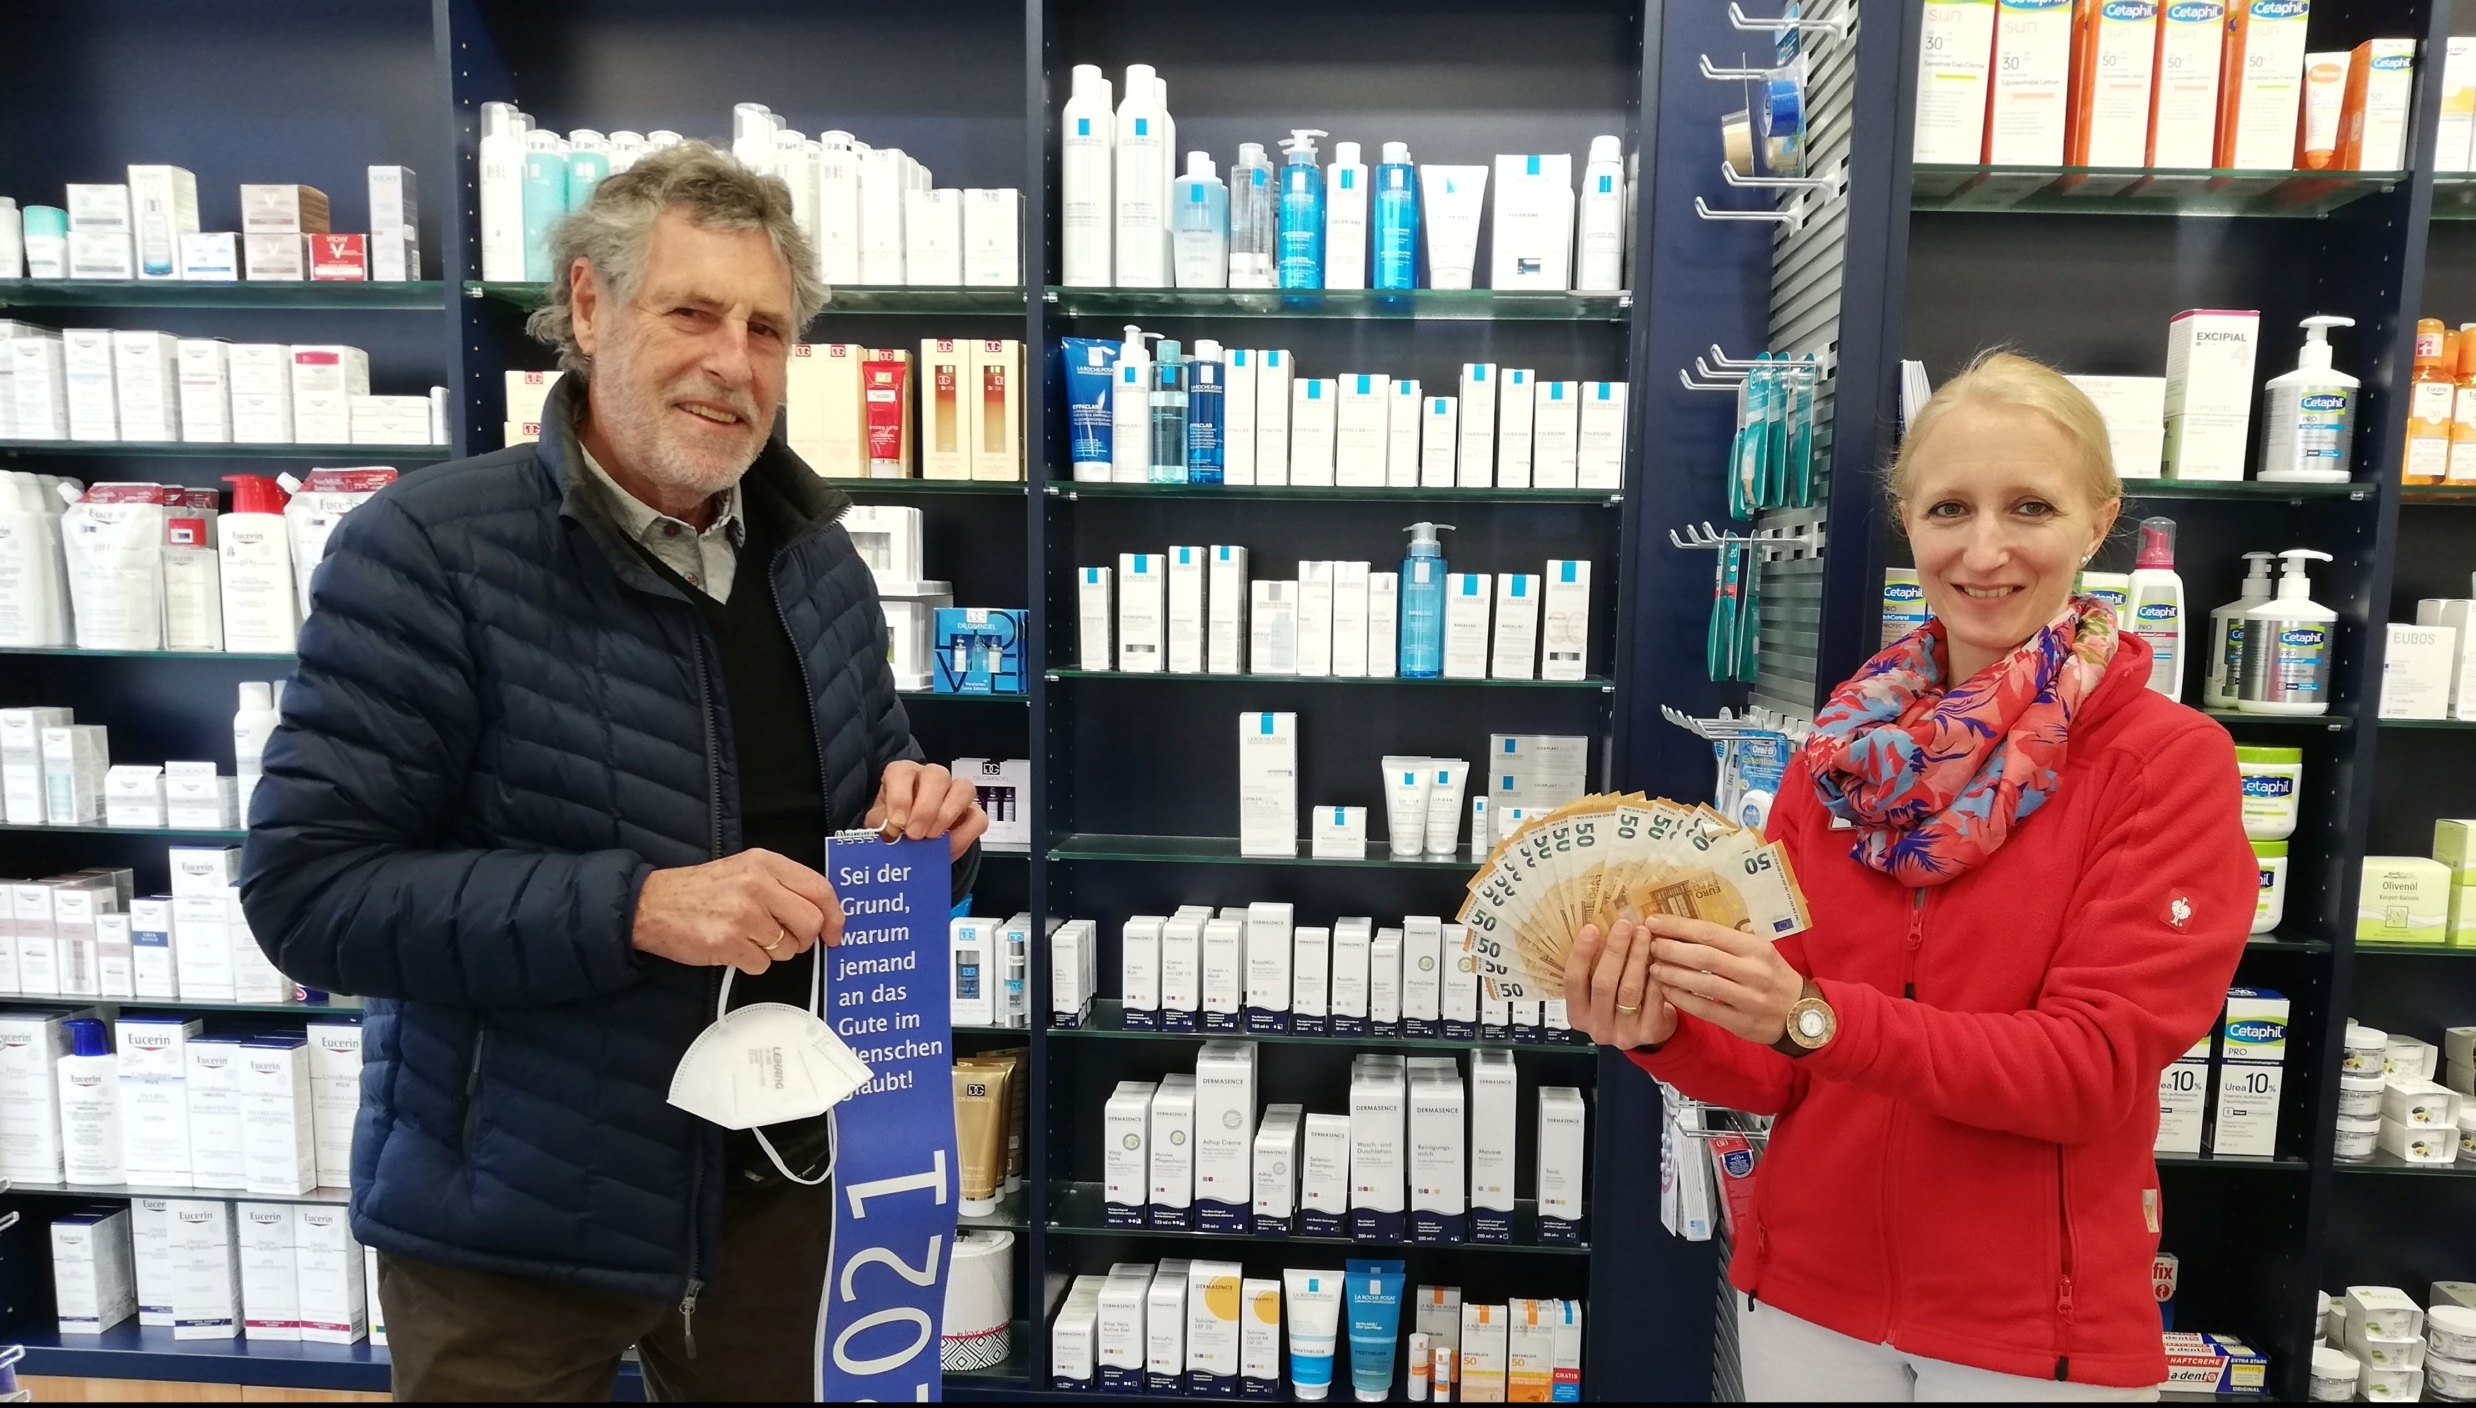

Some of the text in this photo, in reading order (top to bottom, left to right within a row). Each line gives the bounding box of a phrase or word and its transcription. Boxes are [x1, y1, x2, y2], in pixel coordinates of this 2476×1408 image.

[2106, 5, 2154, 19] Cetaphil
[2171, 5, 2221, 20] Cetaphil
[2254, 2, 2303, 16] Cetaphil
[1928, 9, 1962, 22] sun
[2004, 21, 2037, 34] sun
[2104, 27, 2131, 38] sun
[1925, 36, 1943, 50] 30
[2002, 56, 2020, 70] 30
[2373, 57, 2411, 69] Cetaphil
[2311, 69, 2342, 79] Tester
[372, 173, 399, 183] VICHY
[325, 234, 350, 243] VICHY
[330, 243, 346, 260] V
[2196, 331, 2248, 343] EXCIPIAL
[2231, 343, 2251, 368] 4
[2426, 385, 2449, 394] Eucerin
[2303, 397, 2345, 410] Cetaphil
[231, 530, 265, 541] Eucerin
[1884, 587, 1923, 599] Cetaphil
[2139, 606, 2176, 618] Cetaphil
[2282, 633, 2322, 645] Cetaphil
[2393, 632, 2436, 645] EUBOS
[1751, 744, 1776, 756] Oral-B
[1617, 813, 1640, 841] 50
[1648, 814, 1673, 841] 50
[1575, 822, 1595, 848] 50
[181, 861, 214, 872] Eucerin
[1744, 852, 1773, 875] 50
[840, 863, 912, 887] Sei der
[1695, 884, 1722, 899] EURO
[2382, 881, 2418, 892] Olivenöl
[2379, 894, 2420, 902] Körper-Balsam
[840, 893, 911, 916] Grund,
[1471, 908, 1498, 933] 50
[840, 926, 910, 946] warum
[1477, 937, 1502, 960] 50
[836, 951, 917, 981] jemand
[838, 983, 908, 1005] an das
[1500, 982, 1524, 998] 50
[838, 1012, 921, 1037] Gute im
[0, 1032, 33, 1044] ucerin
[2230, 1024, 2283, 1041] Cetaphil
[127, 1033, 172, 1046] Eucerin
[321, 1037, 360, 1049] Eucerin
[851, 1040, 943, 1064] enschen
[2228, 1047, 2248, 1056] PRO
[196, 1055, 228, 1066] Eucerin
[250, 1060, 282, 1071] Eucerin
[70, 1075, 103, 1084] Eucerin
[1202, 1078, 1244, 1086] DERMASENCE
[1108, 1115, 1142, 1123] DERMASENCE
[1546, 1117, 1580, 1125] DERMASENCE
[1310, 1131, 1345, 1139] DERMASENCE
[1221, 1139, 1242, 1147] Creme
[1356, 1141, 1379, 1149] Wasch-
[1417, 1143, 1453, 1152] Reinigungs-
[1478, 1148, 1502, 1156] Mousse
[1155, 1157, 1187, 1166] Pflegeschaum
[1309, 1156, 1331, 1164] Selensiv
[1546, 1168, 1560, 1176] Tonic
[179, 1210, 213, 1221] Eucerin
[250, 1211, 282, 1222] Eucerin
[304, 1213, 333, 1224] Eucerin
[60, 1234, 84, 1244] Eucerin
[1195, 1283, 1234, 1291] DERMASENCE
[1195, 1317, 1218, 1325] Solvinea
[1463, 1357, 1478, 1366] 50
[1511, 1358, 1525, 1367] 50
[2170, 1356, 2221, 1366] HAFTCREME
[1555, 1372, 1578, 1380] GRATIS
